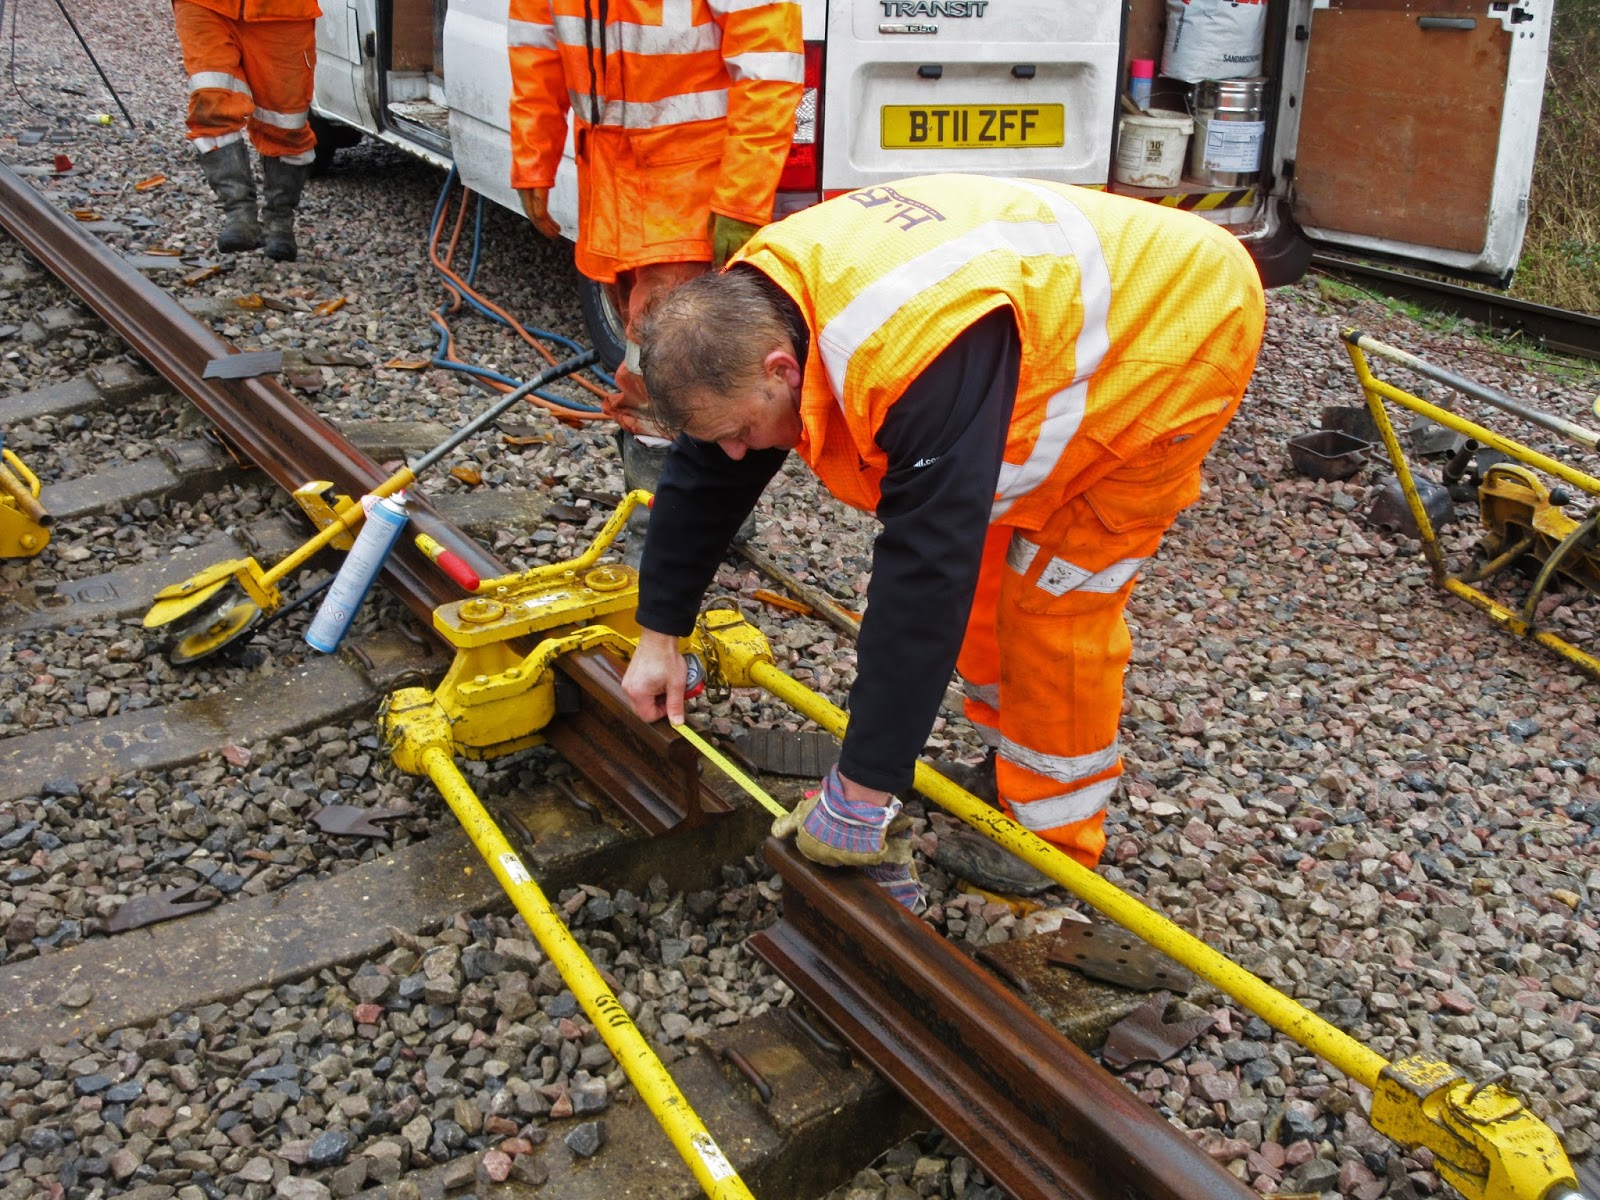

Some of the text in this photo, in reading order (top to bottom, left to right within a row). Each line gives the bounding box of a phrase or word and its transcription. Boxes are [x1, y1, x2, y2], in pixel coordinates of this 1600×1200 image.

[880, 0, 988, 18] TRANSIT
[909, 110, 1039, 142] BT11 ZFF
